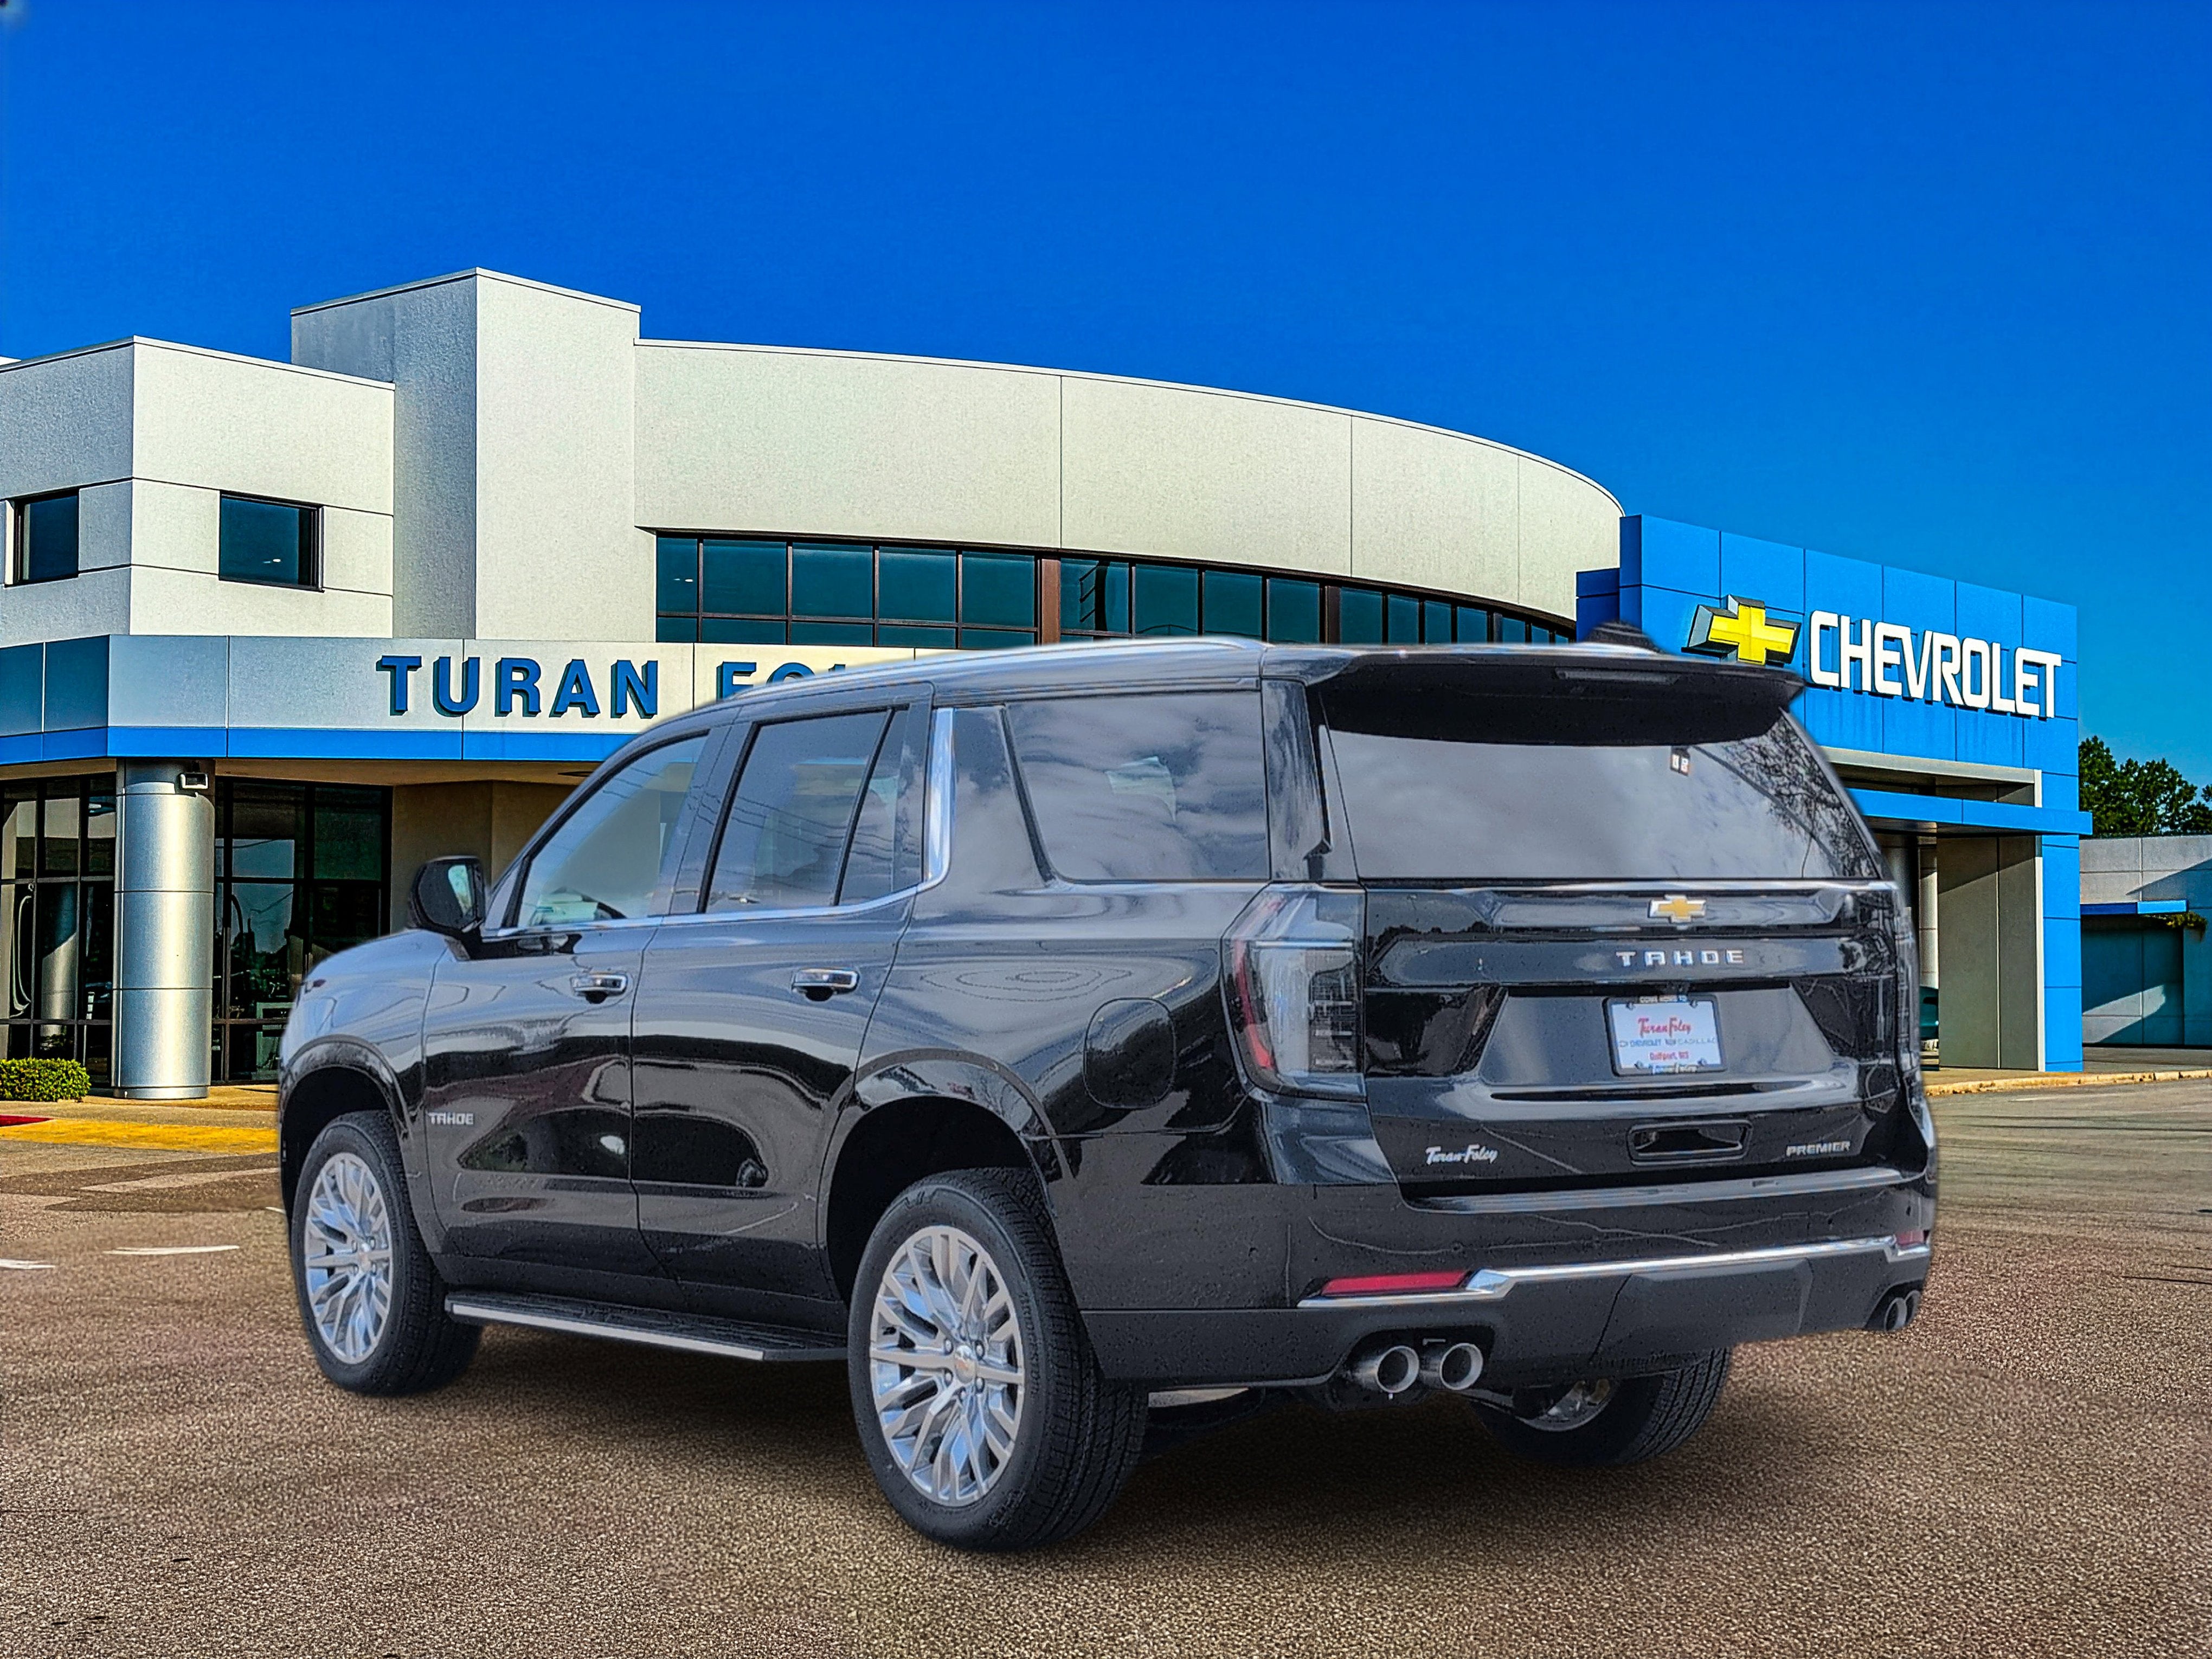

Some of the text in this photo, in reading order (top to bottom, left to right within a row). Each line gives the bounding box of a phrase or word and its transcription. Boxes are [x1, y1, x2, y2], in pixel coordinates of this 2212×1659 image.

[1810, 610, 2061, 719] CHEVROLET
[376, 655, 658, 718] TURAN
[1616, 950, 1743, 967] TAHOE
[427, 1113, 474, 1124] TAHOE
[1786, 1141, 1850, 1156] PREMIER
